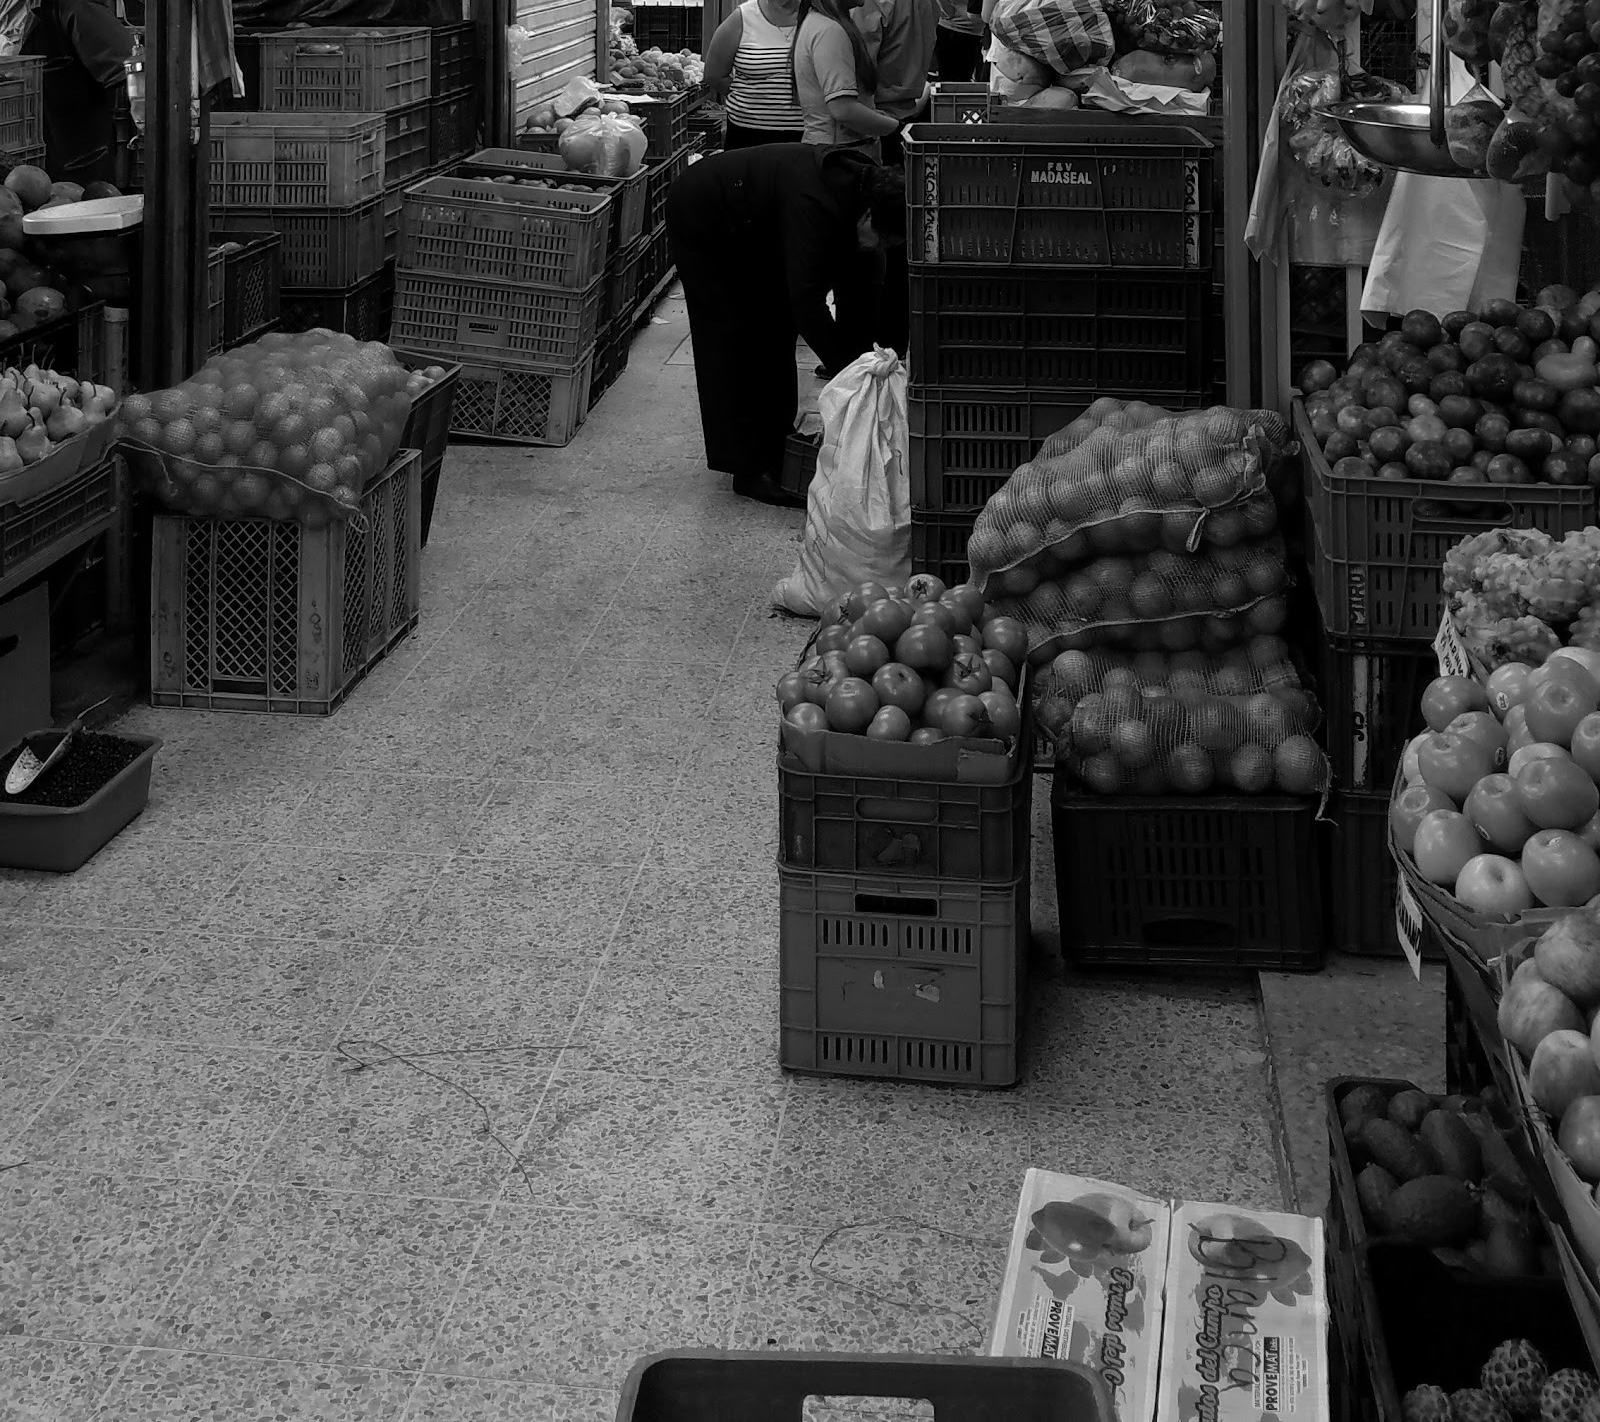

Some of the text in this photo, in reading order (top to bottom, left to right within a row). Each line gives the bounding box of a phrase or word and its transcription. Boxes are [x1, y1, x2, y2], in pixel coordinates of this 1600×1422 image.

[1031, 170, 1093, 185] MADASEAL
[1042, 1299, 1063, 1359] PROVEMAT
[1195, 1283, 1230, 1350] Campo
[1265, 1350, 1278, 1412] PROVEMAT
